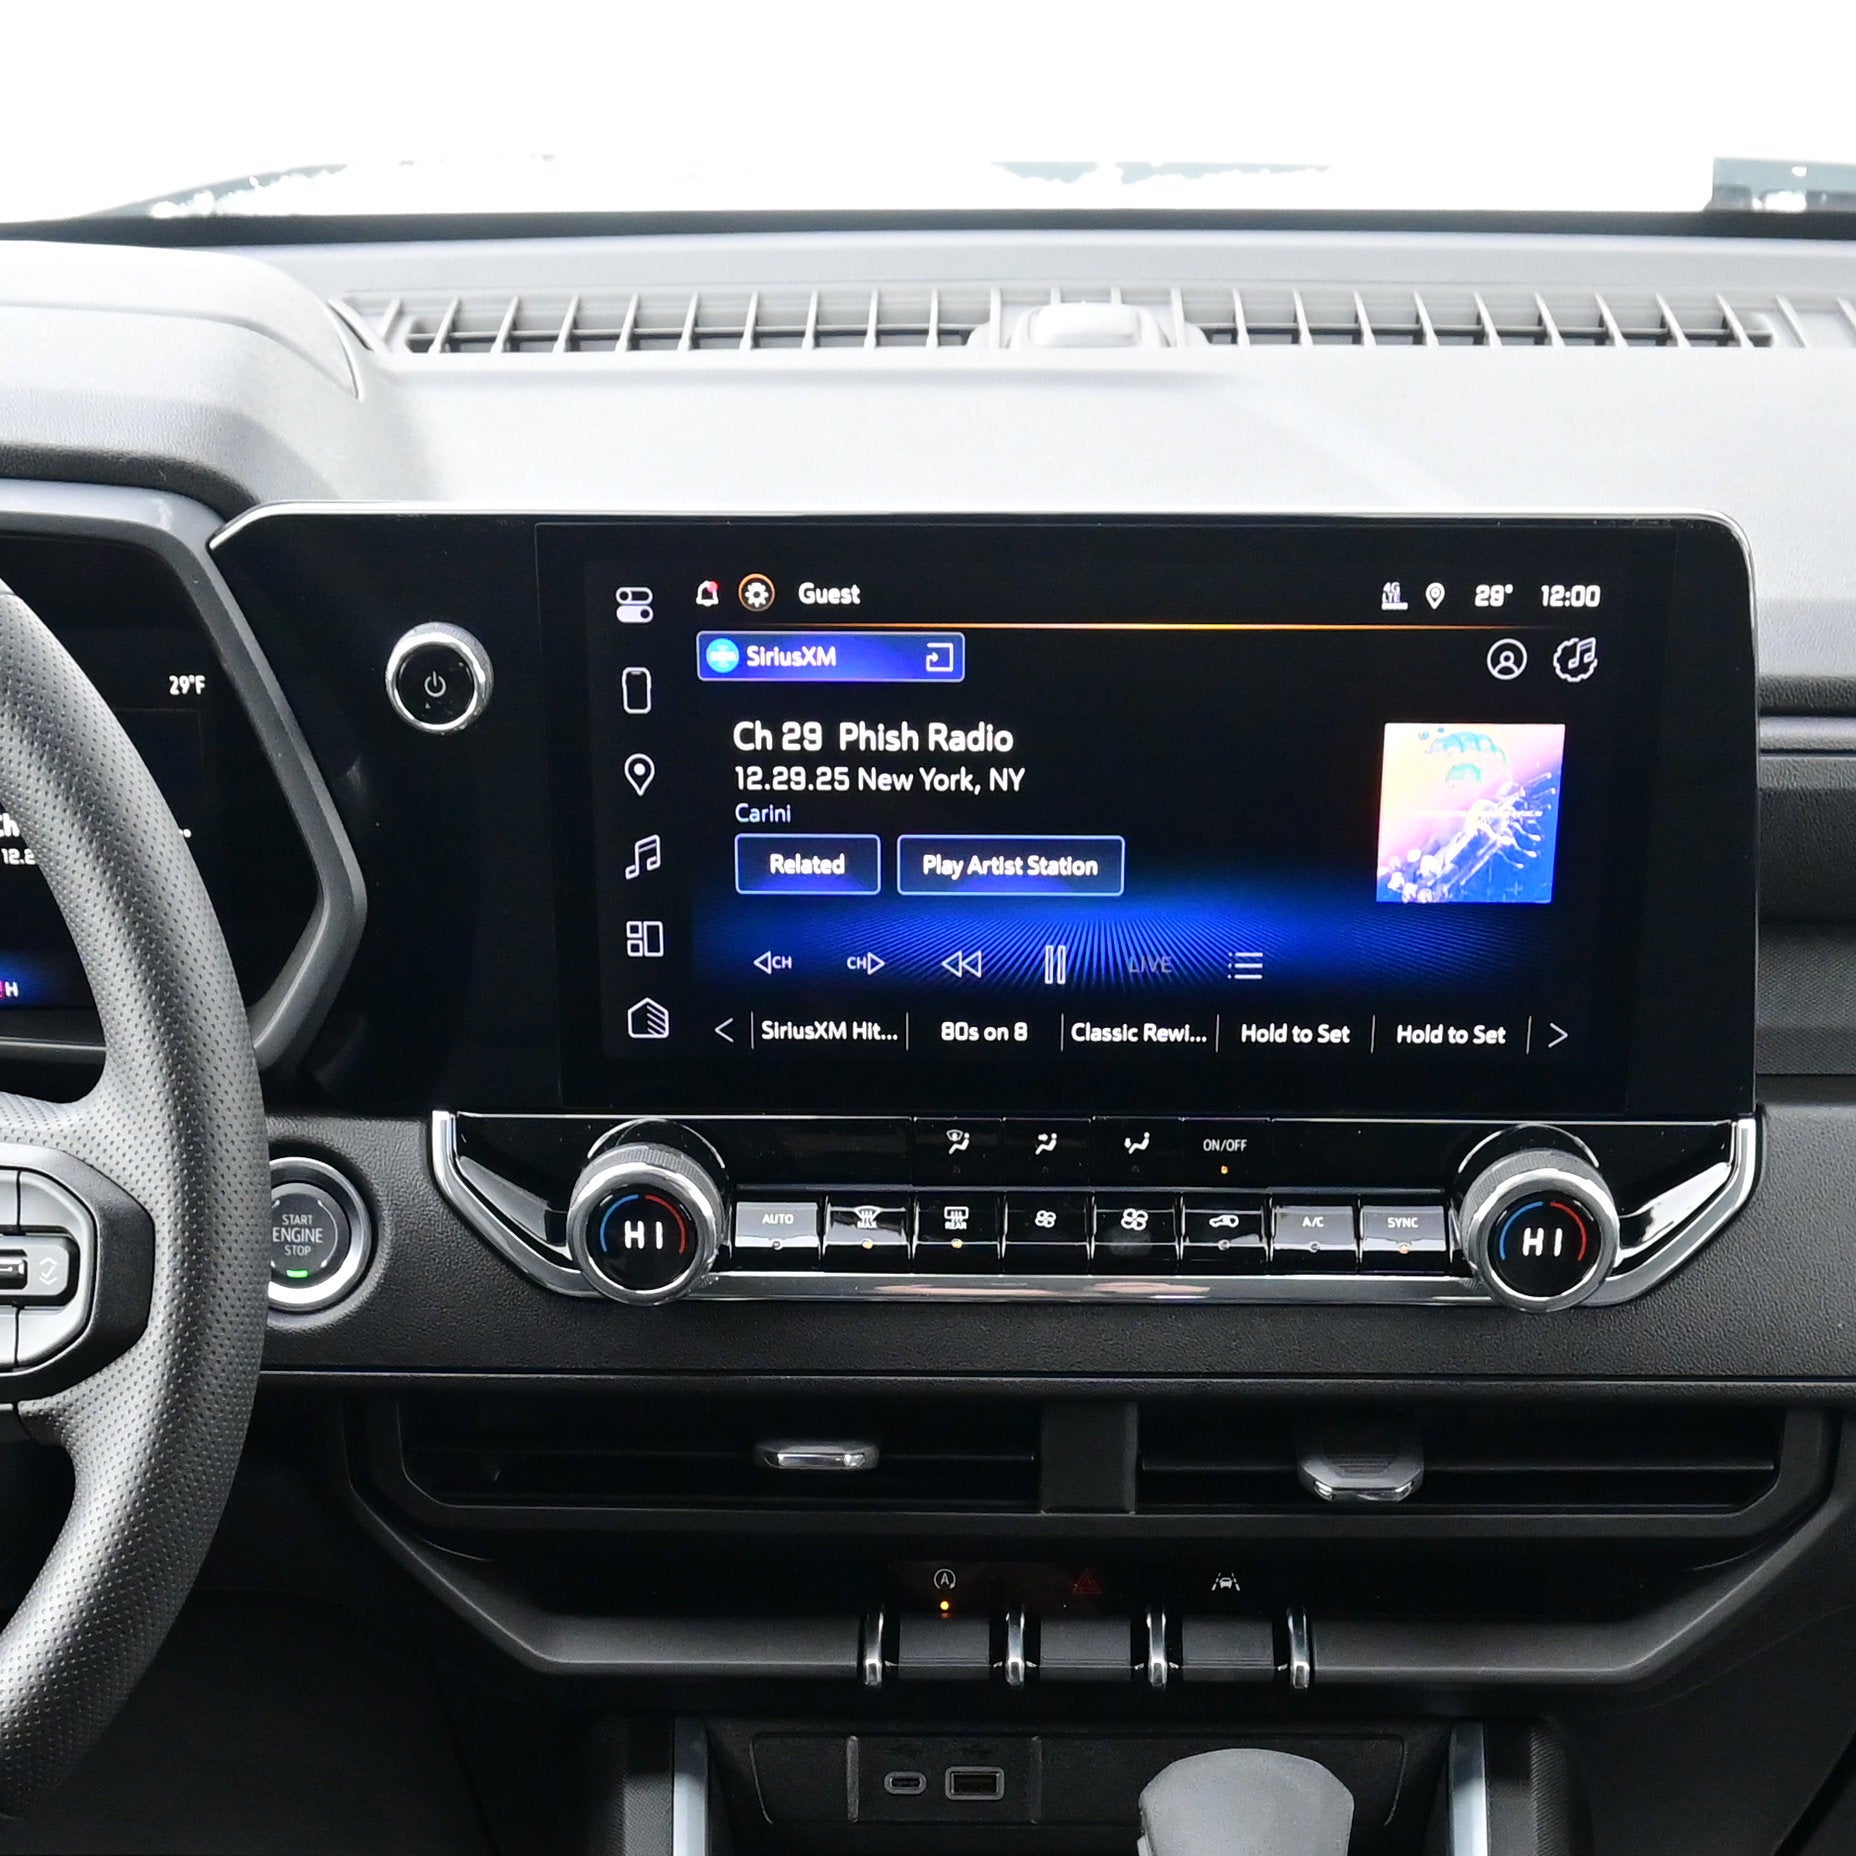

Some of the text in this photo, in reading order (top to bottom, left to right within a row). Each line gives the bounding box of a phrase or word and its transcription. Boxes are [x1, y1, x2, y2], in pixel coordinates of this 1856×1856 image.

[797, 582, 862, 607] Guest
[1474, 583, 1515, 608] 29°
[1540, 584, 1602, 608] 12:00
[745, 645, 837, 669] SiriusXM
[168, 674, 205, 695] 29°F
[732, 720, 1015, 753] Ch 29 Phish Radio
[734, 765, 1026, 797] 12.29.25 New York, NY
[734, 803, 791, 824] Carini
[768, 853, 846, 876] Related
[921, 854, 1100, 880] Play Artist Station
[771, 954, 792, 971] CH
[846, 954, 868, 971] CH
[760, 1020, 899, 1041] SiriusXM Hit...
[940, 1020, 1029, 1041] 80s on 8
[1070, 1021, 1207, 1044] Classic Rewi...
[1240, 1023, 1350, 1045] Hold to Set
[1396, 1024, 1506, 1045] Hold to Set
[1202, 1138, 1247, 1151] ON/OFF
[282, 1214, 312, 1225] START
[761, 1212, 793, 1225] AUTO
[1301, 1215, 1324, 1228] A/C
[1387, 1215, 1419, 1228] SYNC
[272, 1227, 322, 1243] ENGINE
[623, 1219, 664, 1250] HI
[1522, 1226, 1563, 1257] HI
[284, 1245, 310, 1256] STOP
